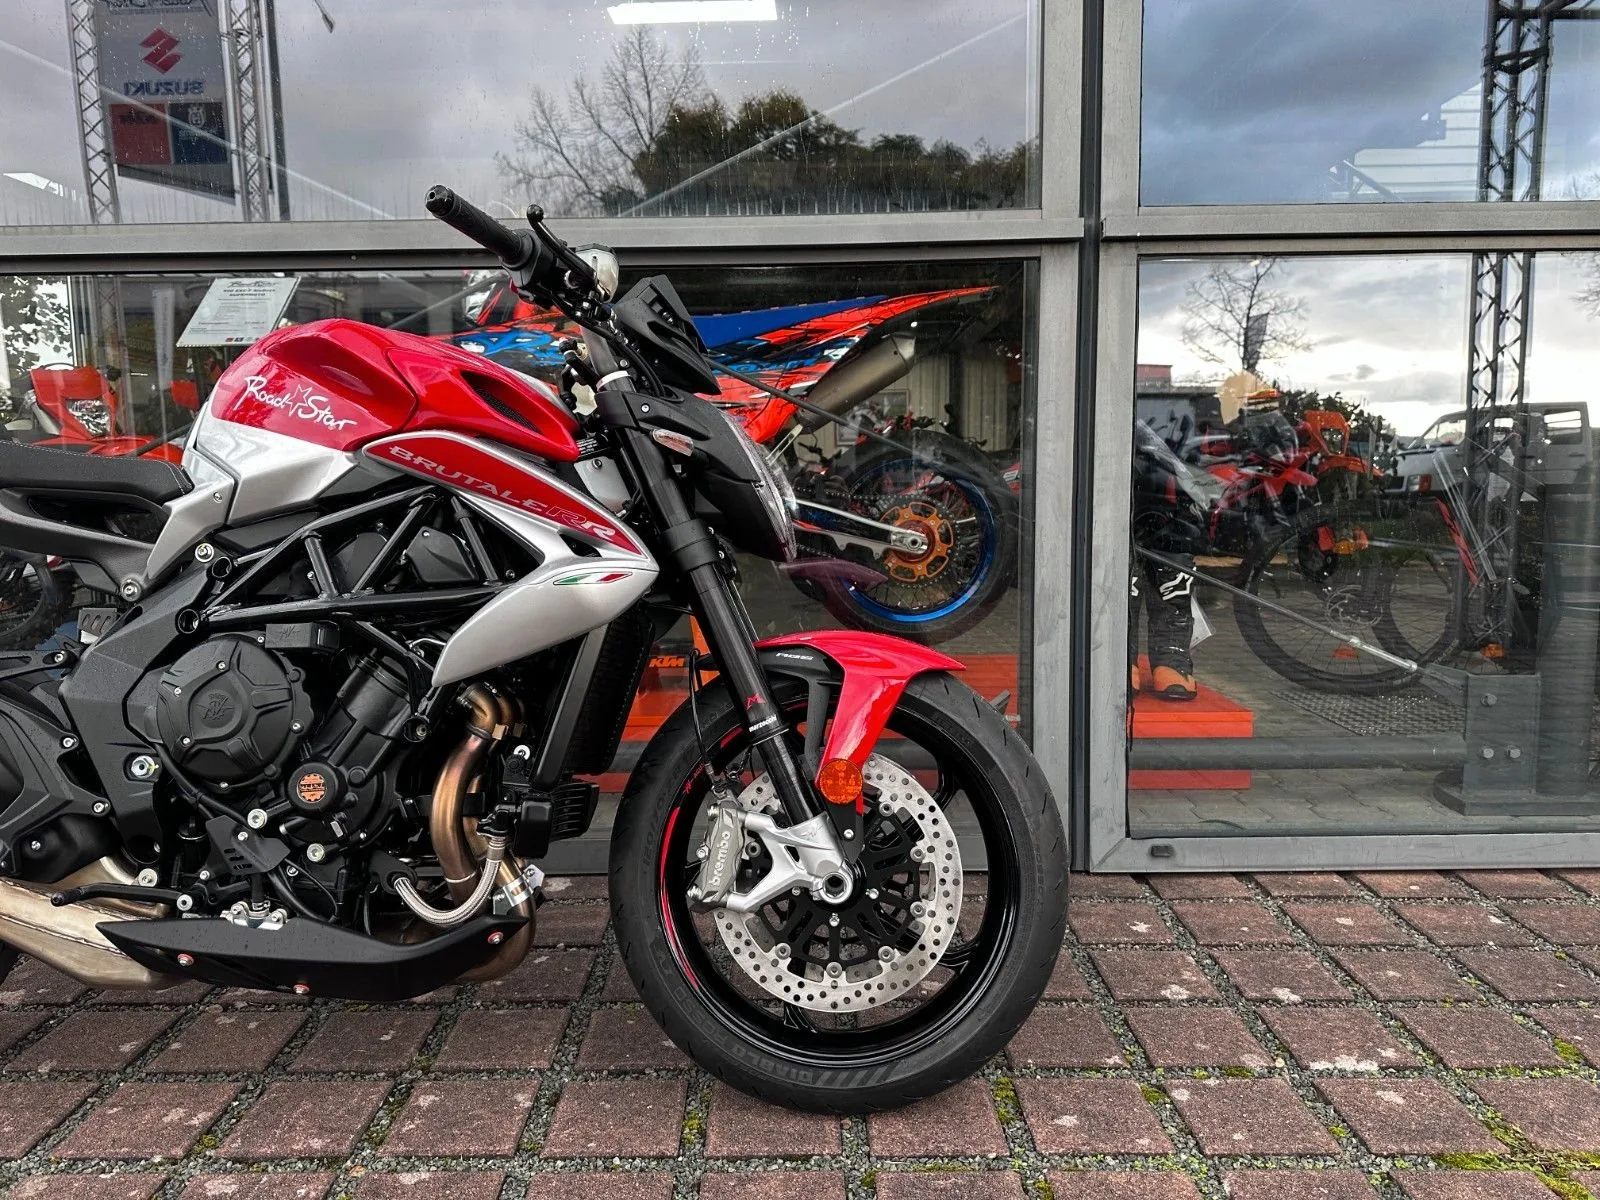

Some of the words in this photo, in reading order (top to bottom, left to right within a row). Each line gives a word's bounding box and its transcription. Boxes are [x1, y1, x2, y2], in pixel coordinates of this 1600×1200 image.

[232, 375, 290, 411] Road
[298, 396, 358, 430] Star
[389, 446, 548, 511] BRUTALE
[648, 655, 685, 668] KTM
[708, 830, 731, 886] brembo
